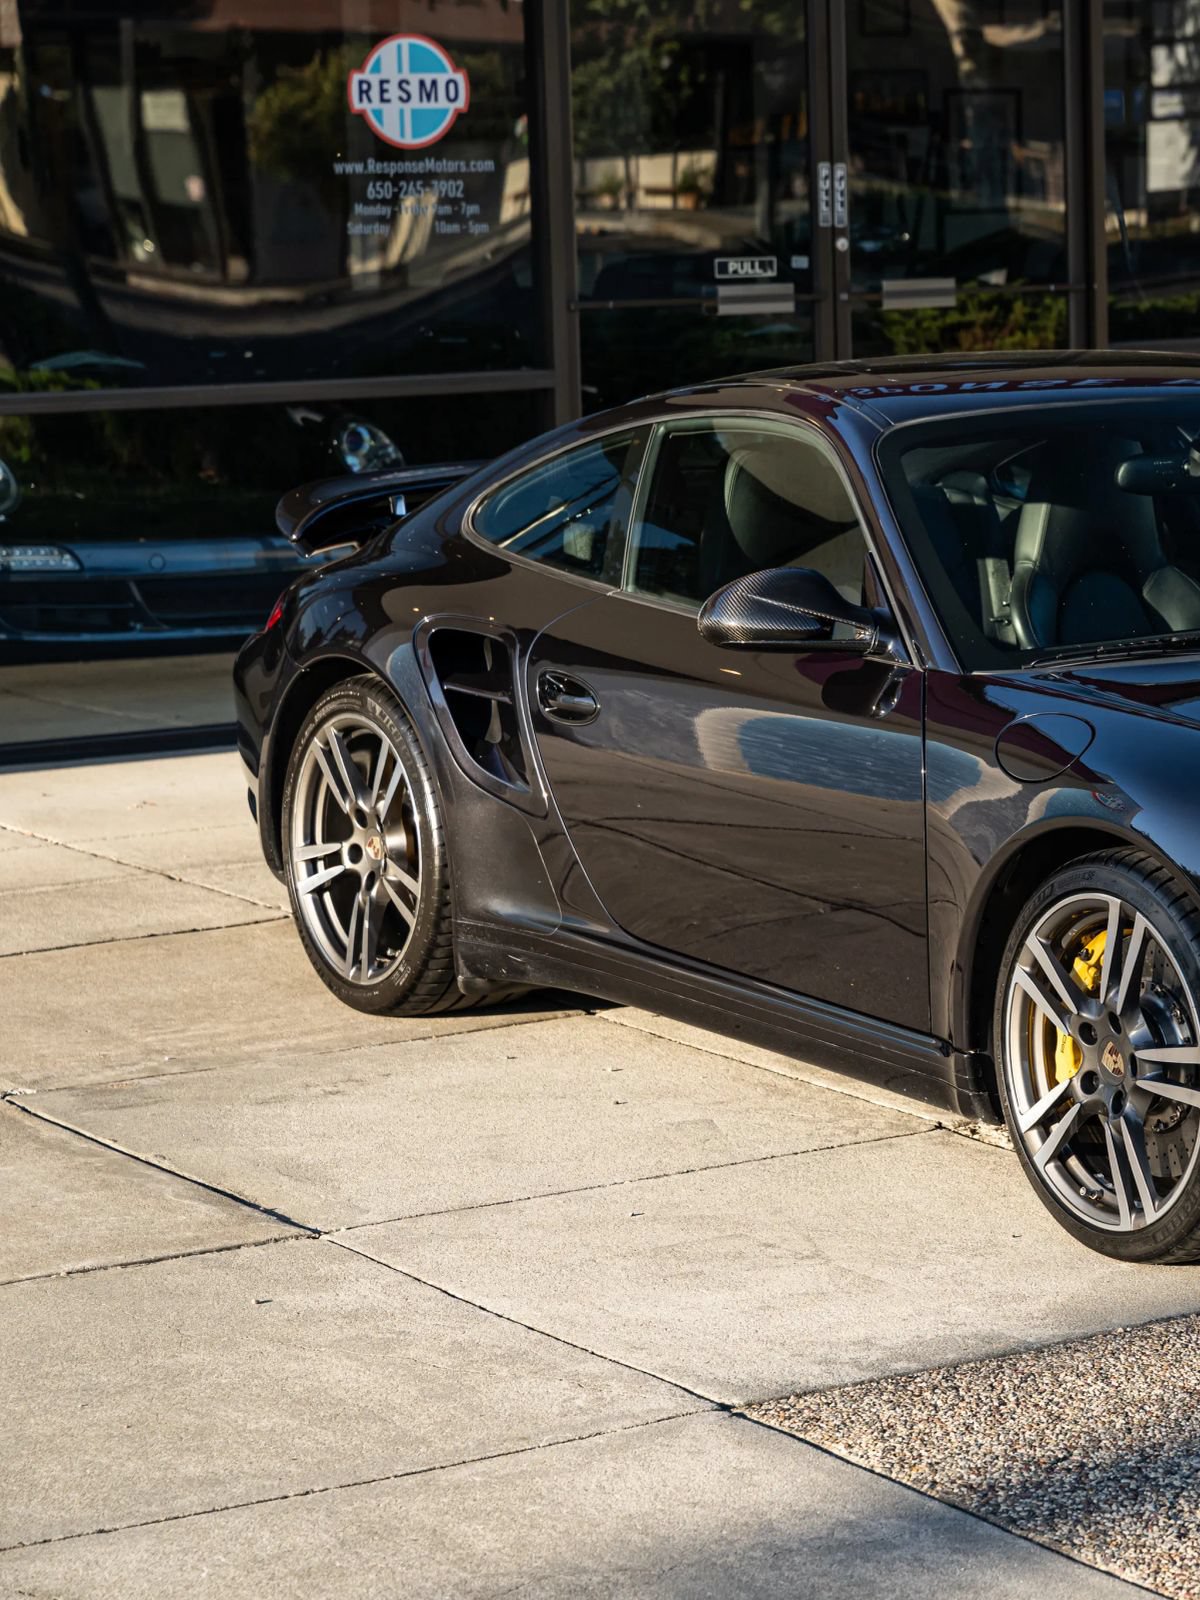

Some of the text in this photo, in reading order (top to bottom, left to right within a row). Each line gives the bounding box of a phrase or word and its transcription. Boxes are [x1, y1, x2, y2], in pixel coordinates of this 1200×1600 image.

[358, 79, 459, 104] RESMO
[333, 157, 495, 177] www.ResponseMotors.com
[354, 203, 392, 219] Monday
[727, 261, 763, 274] PULL
